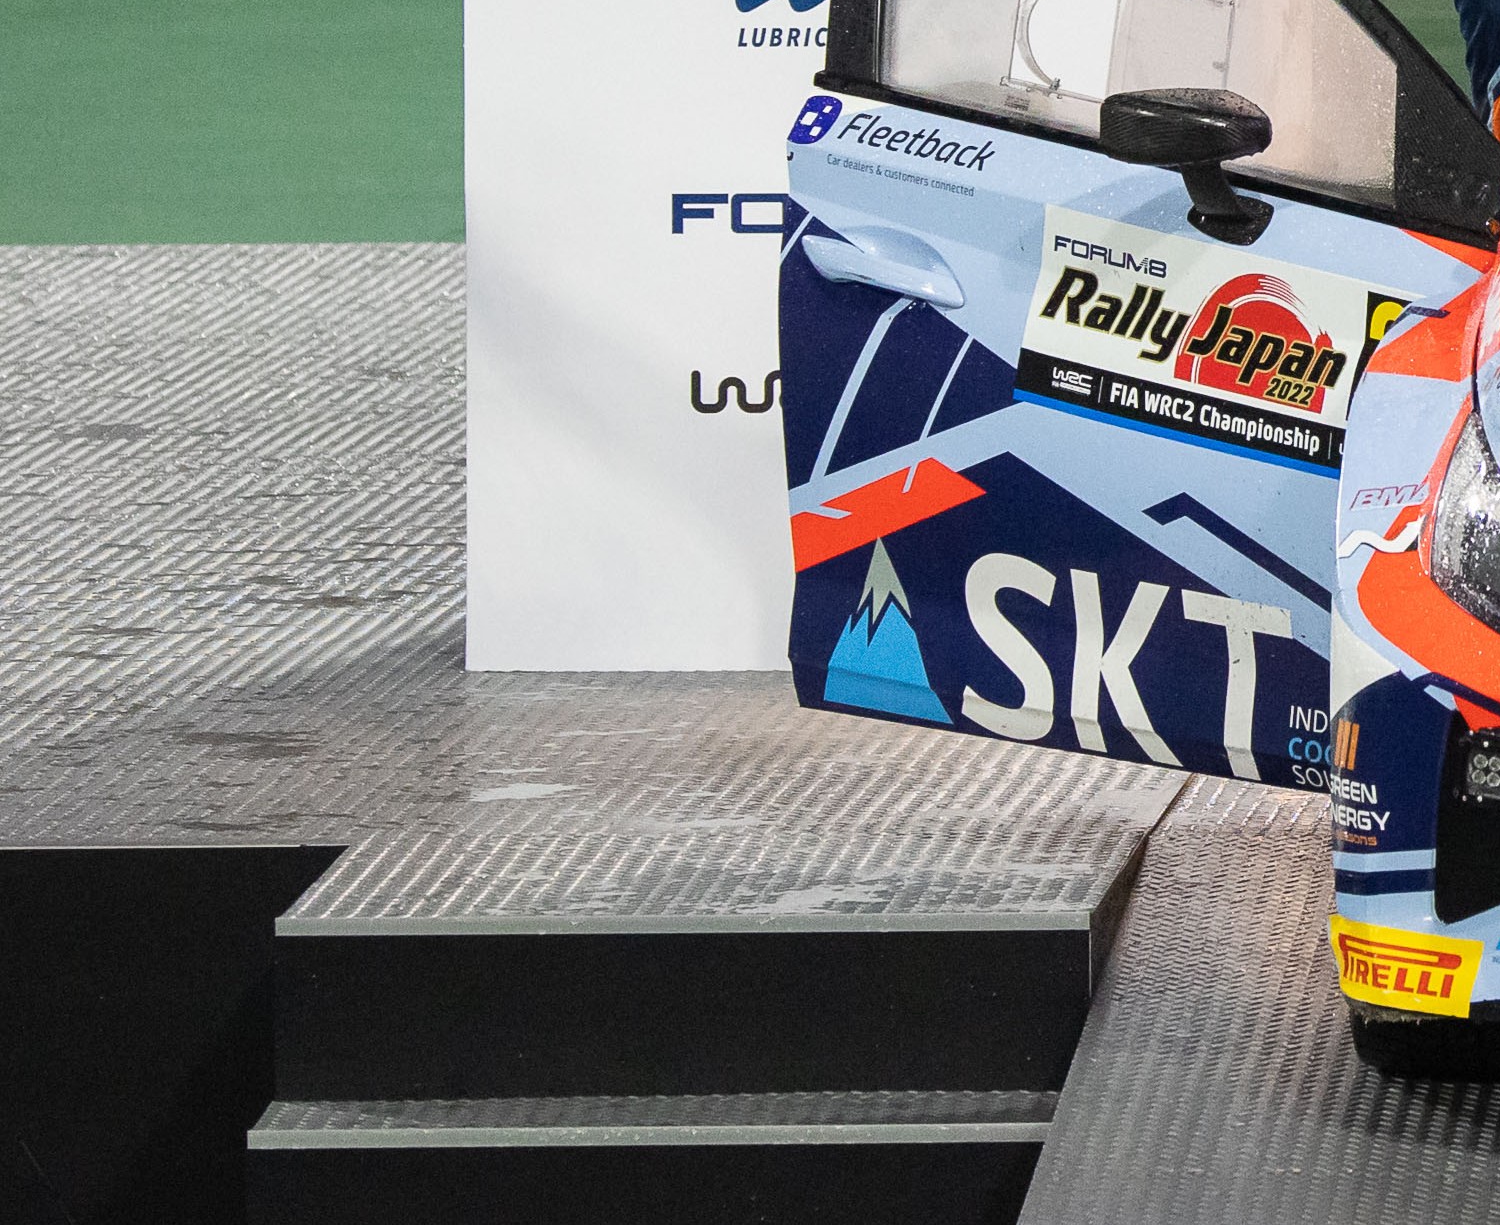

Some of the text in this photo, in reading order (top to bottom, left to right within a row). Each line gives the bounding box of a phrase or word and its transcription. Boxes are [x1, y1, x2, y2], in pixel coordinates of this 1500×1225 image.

[837, 113, 996, 172] Fleetback
[827, 154, 975, 197] Car dealers & customers connected
[1053, 235, 1167, 279] FORUM8
[1039, 266, 1192, 364] Rally
[1186, 303, 1348, 390] Japan
[1052, 366, 1094, 389] WRC
[1109, 382, 1139, 409] FIA
[1144, 389, 1195, 422] WRC2
[1199, 404, 1321, 455] Championship
[1265, 376, 1315, 408] 2022
[959, 552, 1292, 778] SKT
[1338, 932, 1462, 999] PIRELLI
